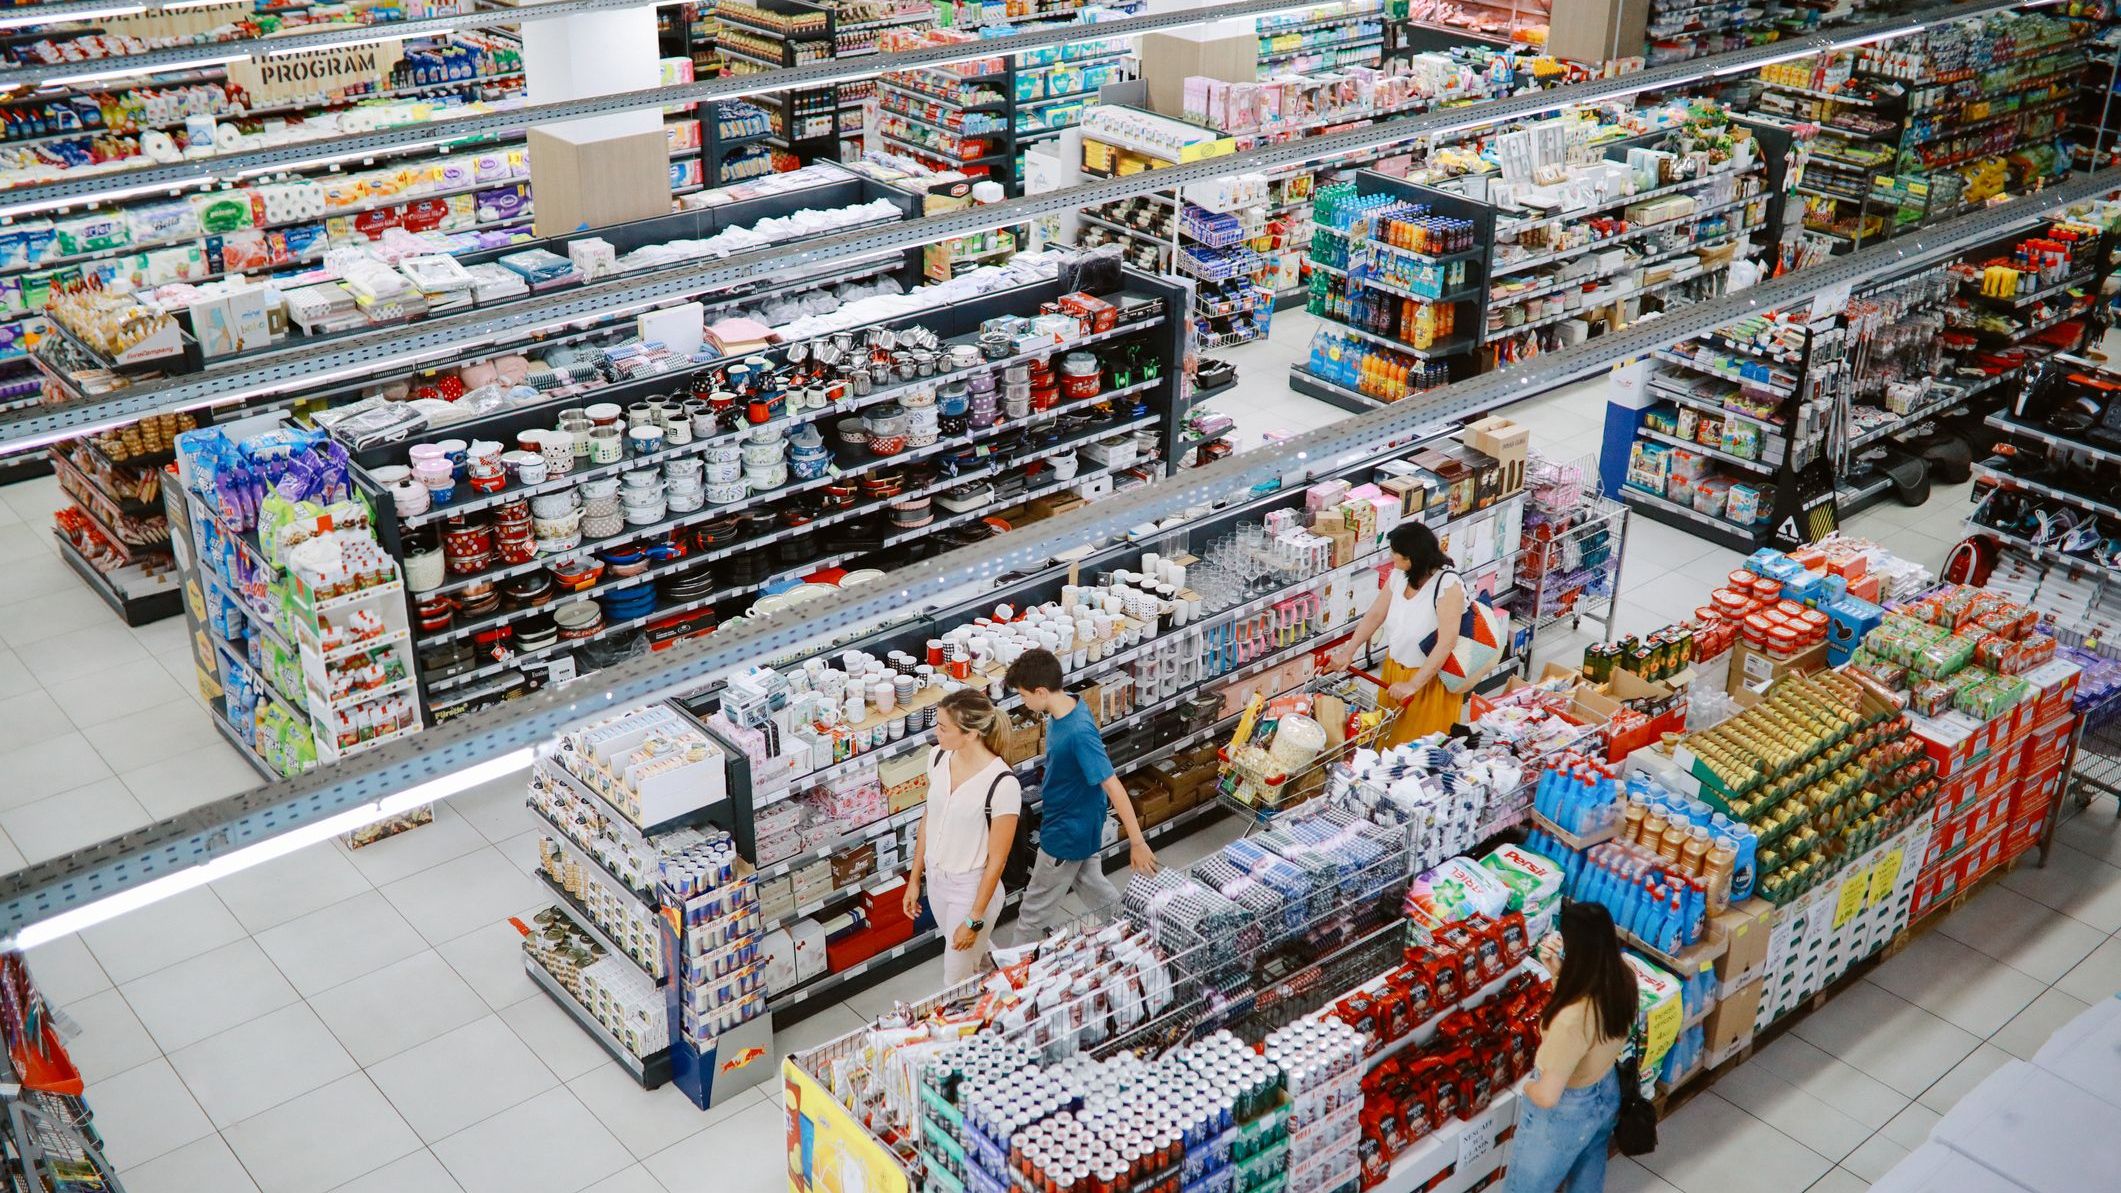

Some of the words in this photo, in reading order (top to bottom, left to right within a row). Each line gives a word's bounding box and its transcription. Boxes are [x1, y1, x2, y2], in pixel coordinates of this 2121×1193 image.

[261, 53, 376, 85] PROGRAM
[1503, 850, 1548, 877] Persil
[1449, 866, 1485, 894] ARIEL
